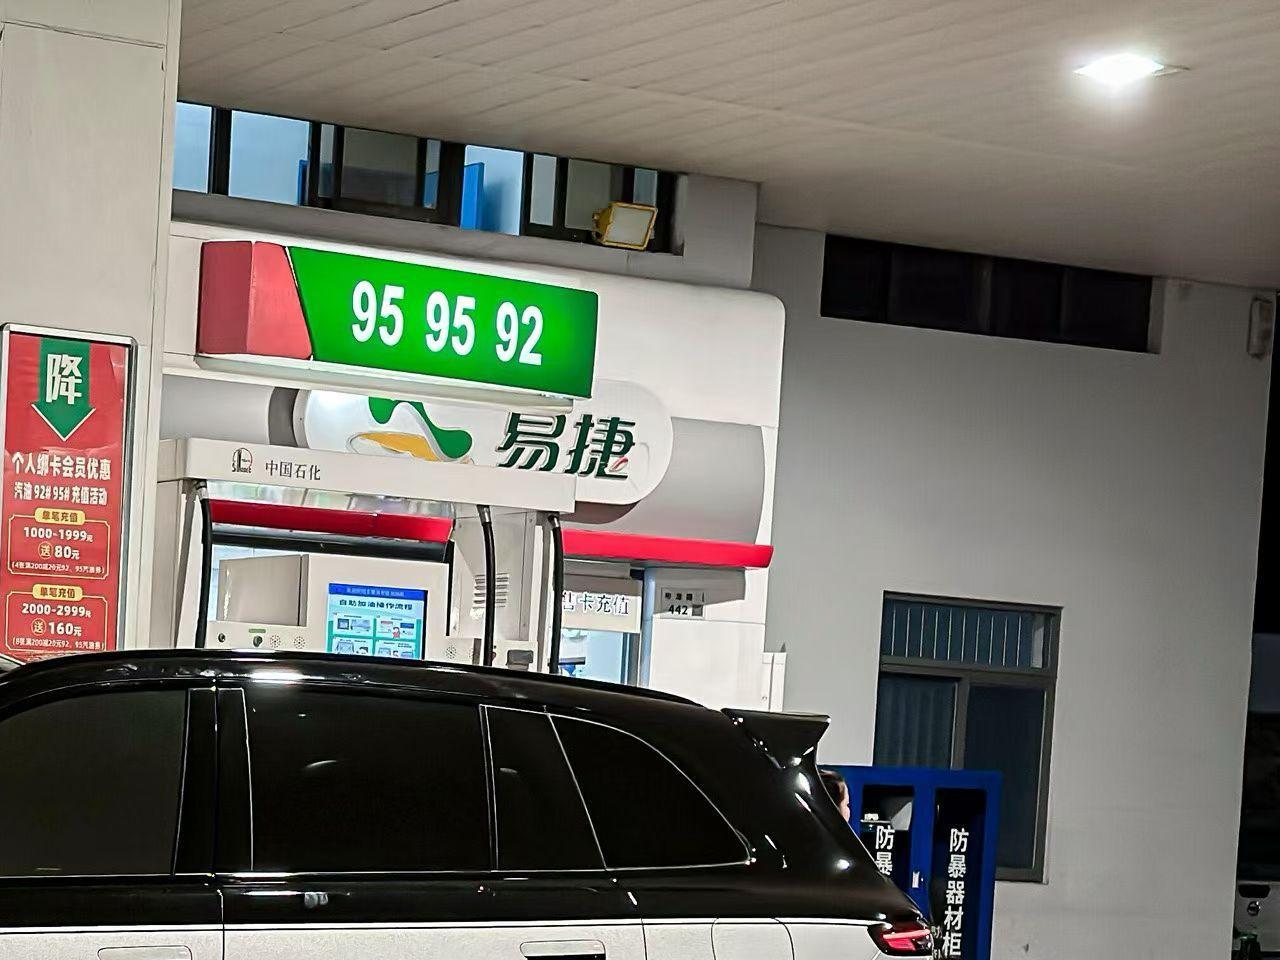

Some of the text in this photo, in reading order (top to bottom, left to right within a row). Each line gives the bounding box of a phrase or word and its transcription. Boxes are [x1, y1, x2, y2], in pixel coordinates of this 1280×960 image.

[351, 280, 544, 366] 95 95 92
[45, 353, 83, 405] 降
[12, 451, 111, 480] 个人绑卡会员优惠
[496, 411, 637, 481] 易捷
[265, 460, 321, 481] 中国石化
[54, 545, 80, 560] 80元
[48, 621, 82, 637] 160元
[668, 604, 688, 615] 442
[875, 825, 895, 876] 防暴
[942, 828, 969, 958] 防暴器材柜
